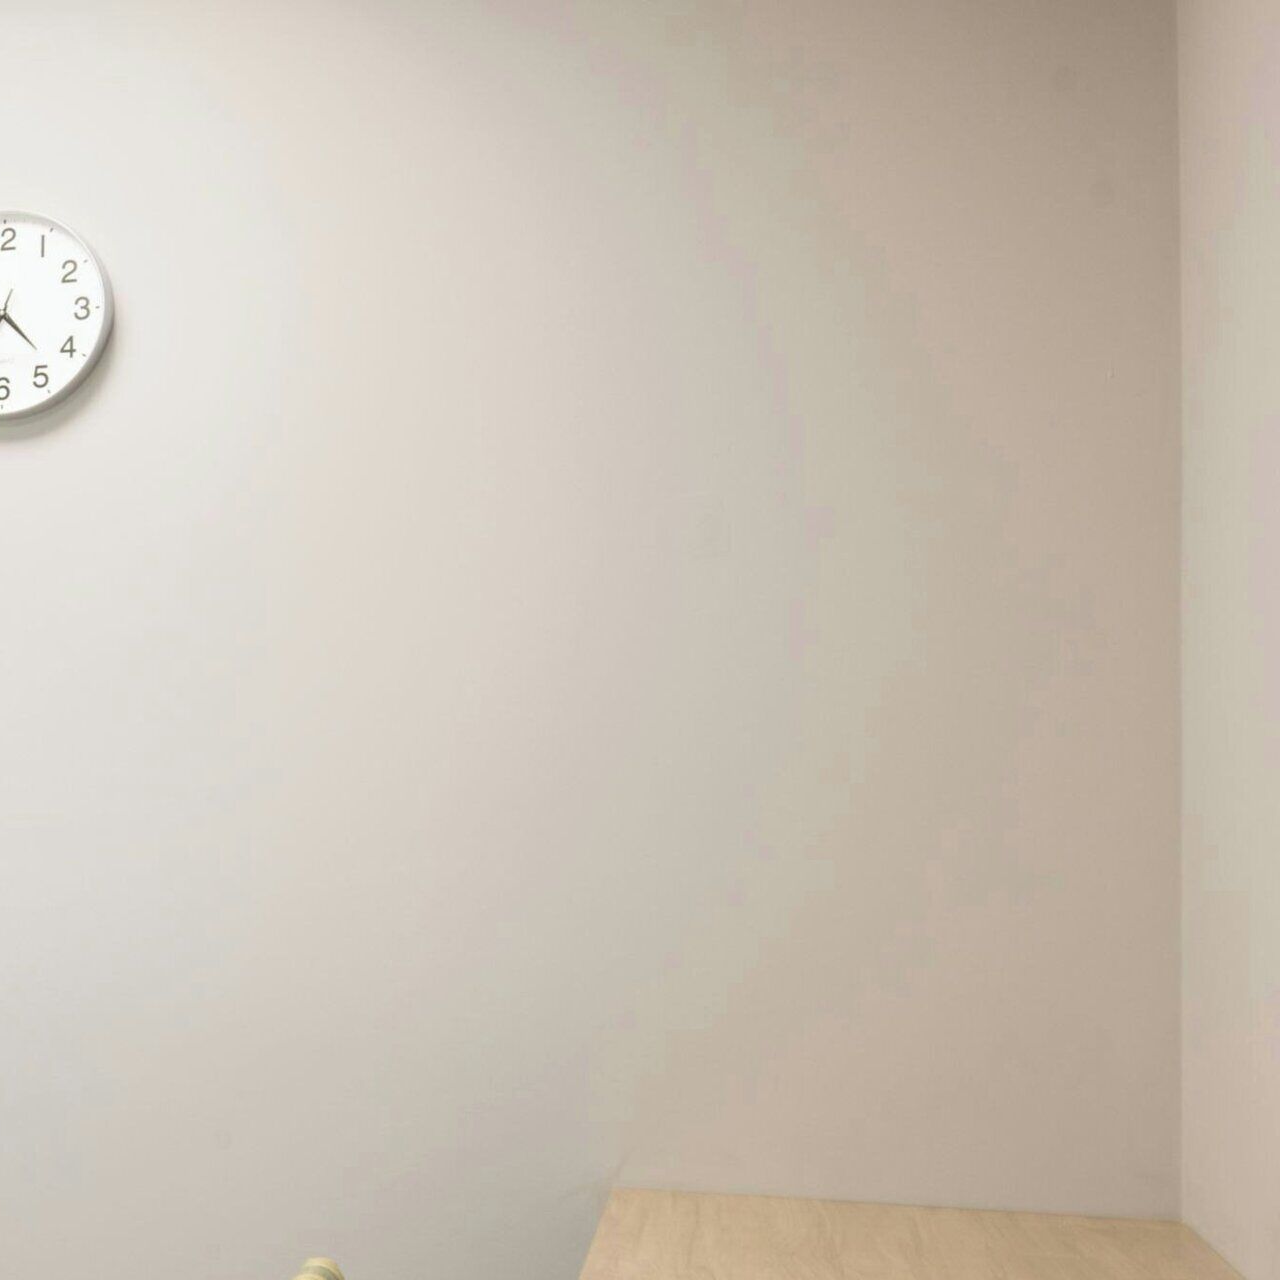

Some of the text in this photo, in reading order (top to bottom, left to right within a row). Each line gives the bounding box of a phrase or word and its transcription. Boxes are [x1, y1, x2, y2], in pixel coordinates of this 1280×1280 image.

[40, 234, 46, 258] 1
[60, 259, 78, 283] 2
[73, 296, 91, 320] 3
[59, 335, 77, 358] 4
[32, 364, 49, 388] 5
